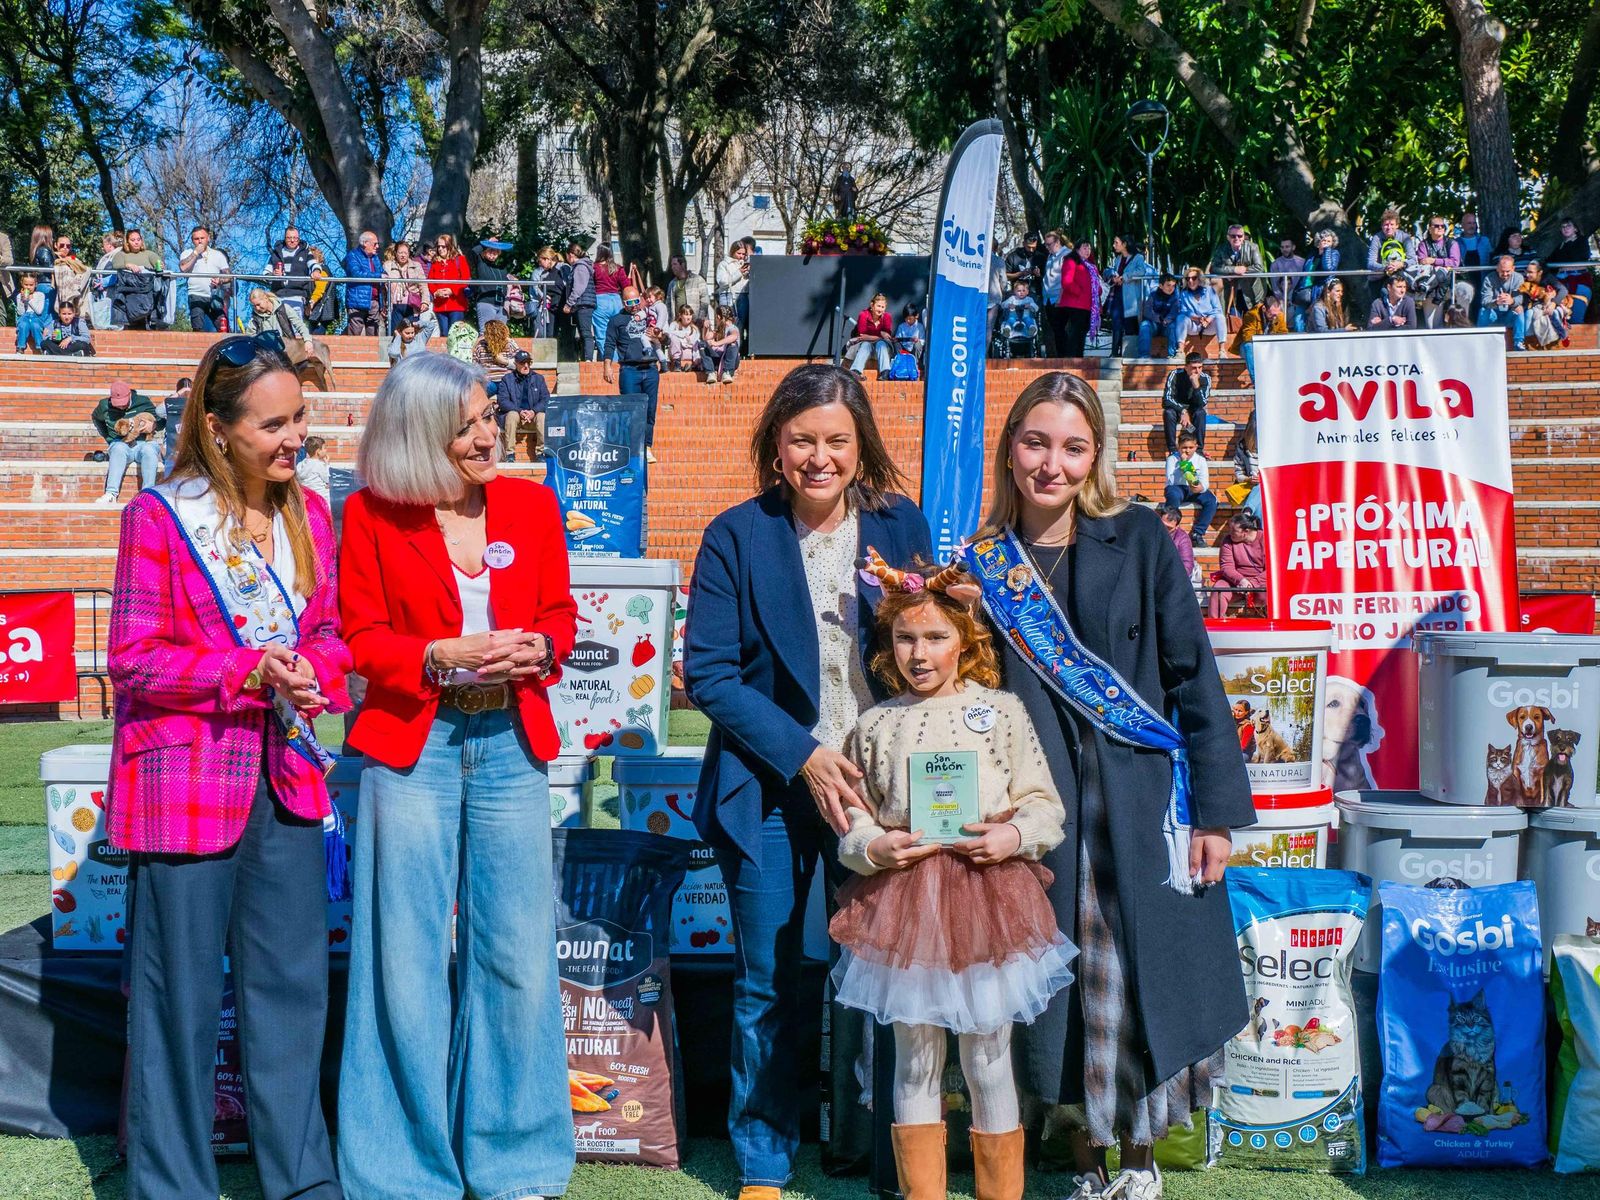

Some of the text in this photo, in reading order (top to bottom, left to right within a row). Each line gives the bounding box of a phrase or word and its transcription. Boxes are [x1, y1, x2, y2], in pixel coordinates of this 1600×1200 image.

[1316, 429, 1380, 445] Animales
[568, 449, 619, 462] ownat
[586, 479, 601, 491] NO
[572, 500, 608, 510] NATURAL
[1296, 594, 1474, 616] SAN FERNANDO
[1331, 622, 1376, 641] IRO
[569, 679, 612, 691] NATURAL
[575, 689, 615, 711] REAL food
[1487, 680, 1580, 709] Gosbi
[933, 753, 951, 764] San
[925, 760, 963, 774] Antón
[1261, 768, 1304, 777] NATURAL
[1398, 851, 1494, 881] Gosbi
[87, 874, 99, 885] The
[106, 887, 121, 896] REAL
[684, 892, 727, 905] VERDAD
[1291, 929, 1342, 947] picart
[1411, 914, 1515, 957] Gosbi
[556, 939, 634, 962] ownat
[567, 964, 620, 975] THE REAL FOOD
[1240, 944, 1340, 982] Selec
[1428, 956, 1502, 978] Exclusive
[583, 996, 606, 1020] NO
[608, 995, 634, 1009] meat
[608, 1007, 635, 1020] meal
[1230, 1052, 1264, 1063] CHICKEN
[1282, 1058, 1302, 1066] RICE
[610, 1062, 650, 1076] 60% FRESH
[625, 1110, 640, 1118] FREE
[598, 1127, 617, 1135] FOOD
[586, 1140, 615, 1148] ROOSTER
[1433, 1139, 1515, 1149] Chicken & Turkey
[1457, 1150, 1492, 1158] ADULT
